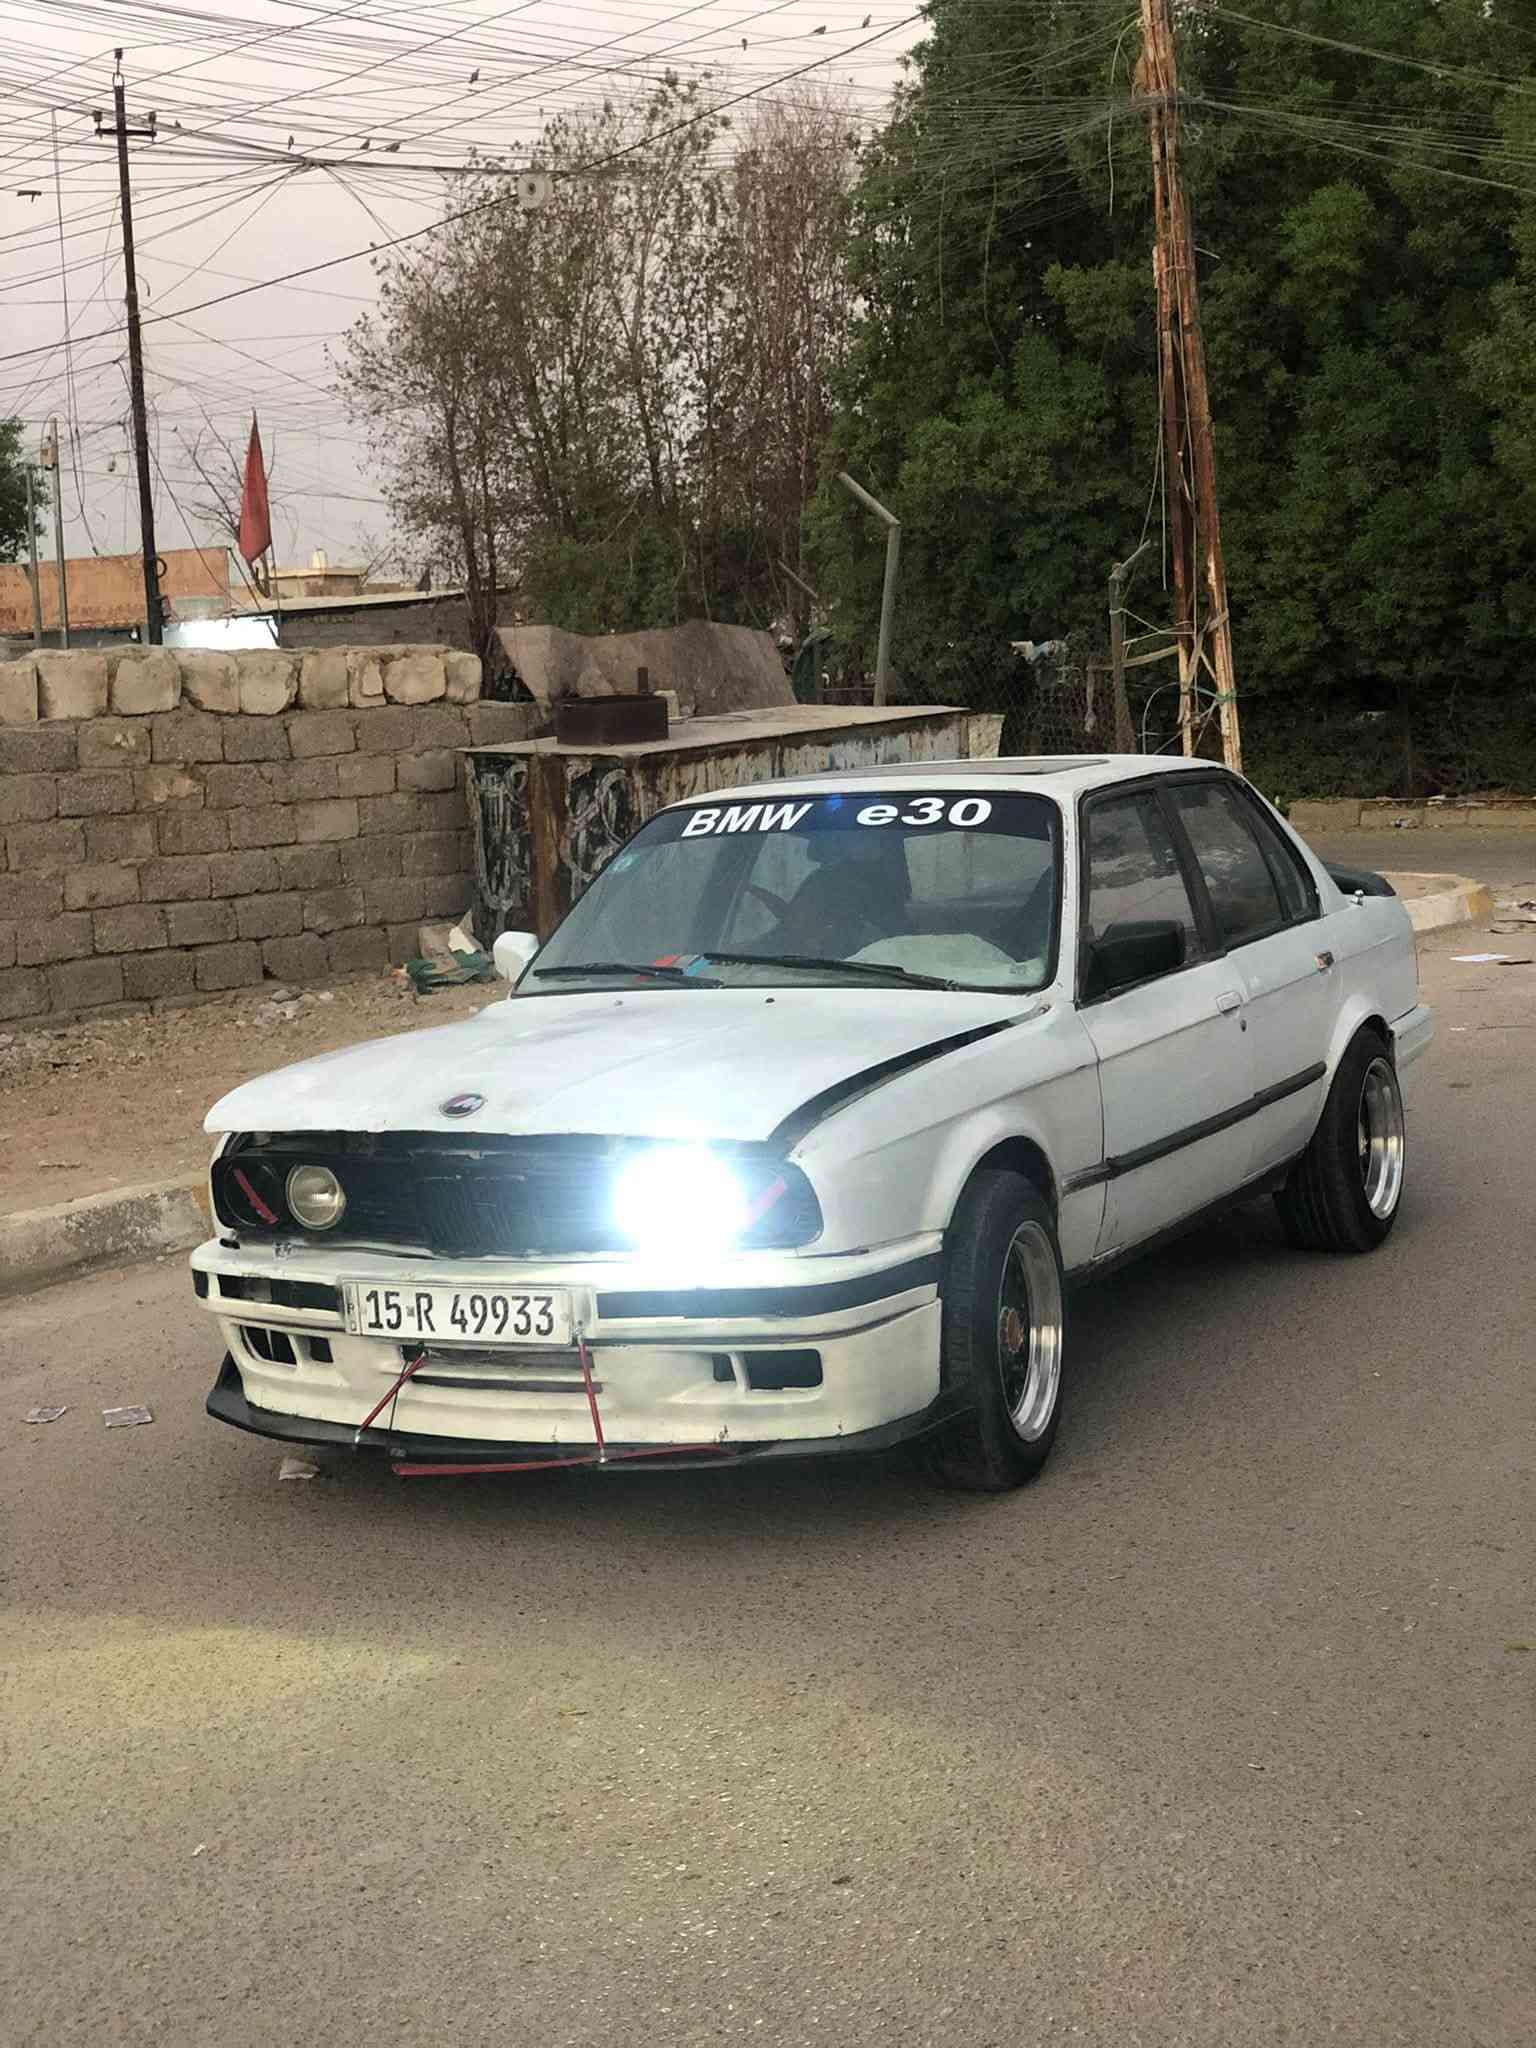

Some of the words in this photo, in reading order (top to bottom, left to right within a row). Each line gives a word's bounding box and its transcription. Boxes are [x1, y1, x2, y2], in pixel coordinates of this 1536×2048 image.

[681, 803, 813, 837] BMW
[856, 798, 992, 826] e30
[366, 1290, 402, 1330] 15
[416, 1293, 436, 1332] R
[450, 1294, 554, 1336] 49933
